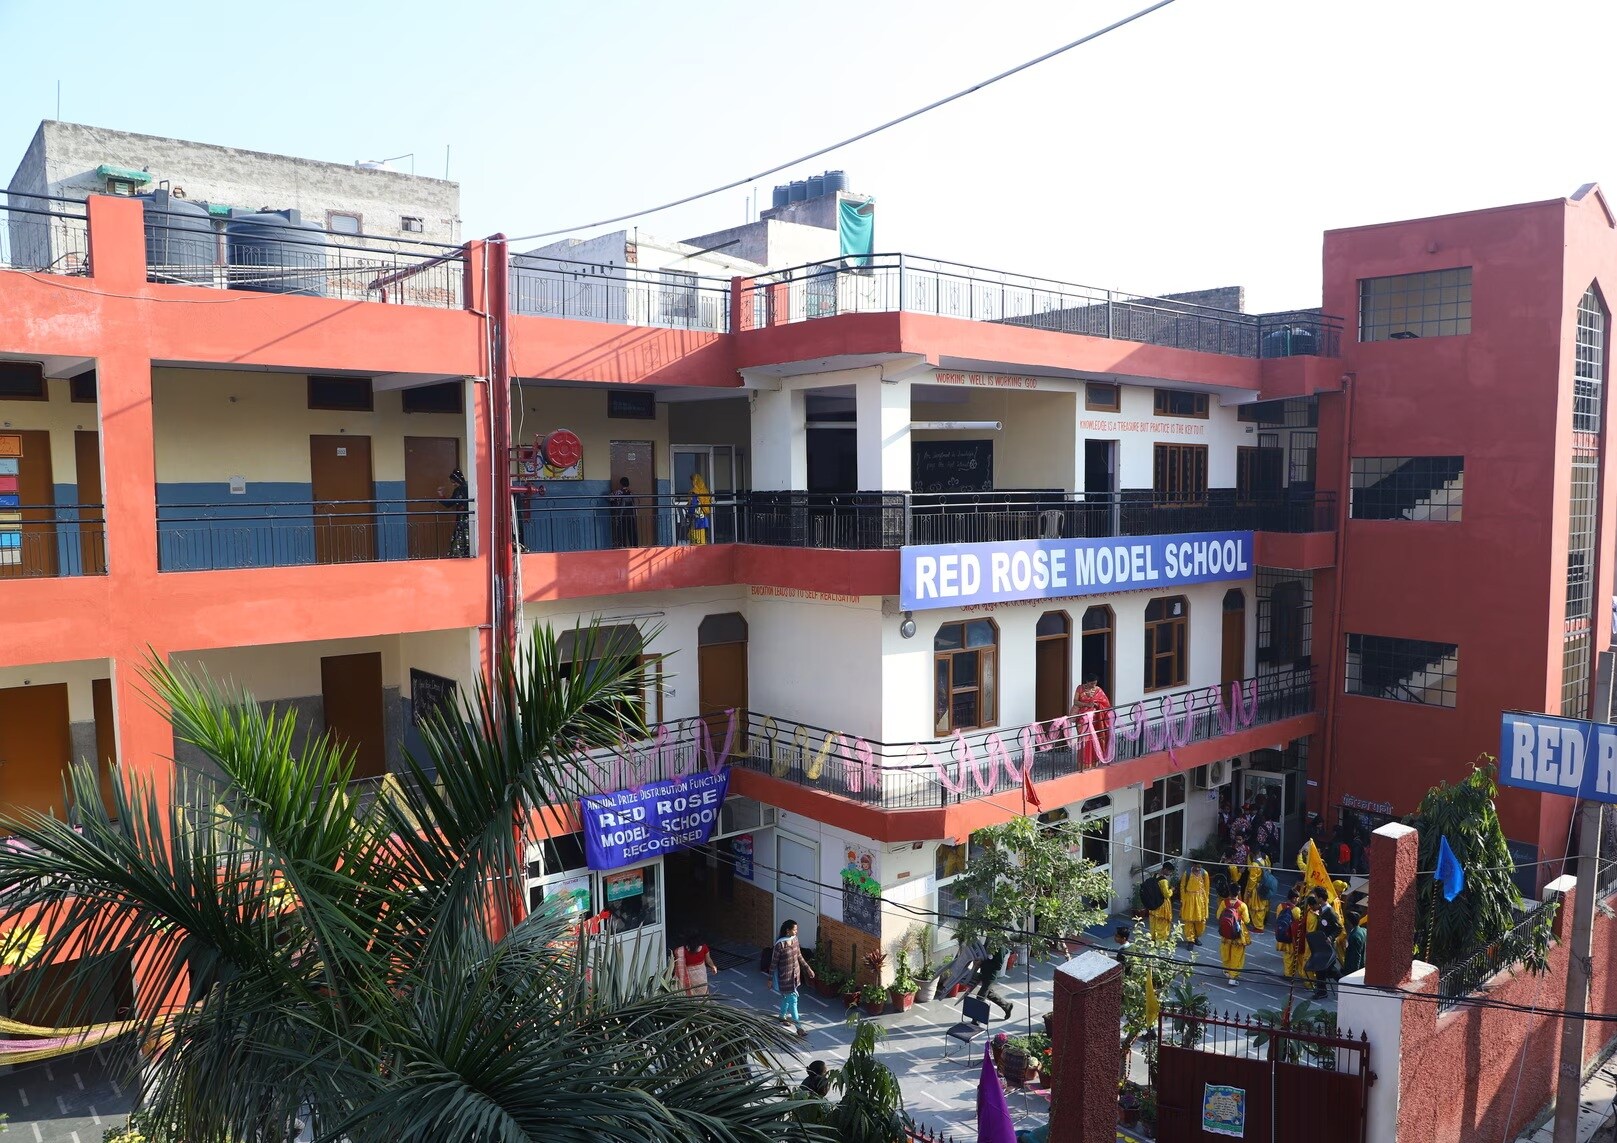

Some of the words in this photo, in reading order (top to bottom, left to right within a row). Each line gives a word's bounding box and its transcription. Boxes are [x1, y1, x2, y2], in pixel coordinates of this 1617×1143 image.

[936, 373, 965, 384] WORKING
[969, 374, 985, 386] WELL
[988, 375, 993, 386] IS
[995, 376, 1022, 387] WORKING
[1080, 420, 1107, 431] KNOWLEDGE
[1117, 421, 1139, 432] TREASURE
[1140, 422, 1149, 433] BUT
[1150, 422, 1170, 434] PRACTICE
[1176, 424, 1184, 434] THE
[915, 553, 981, 600] RED
[991, 549, 1067, 593] ROSE
[1075, 544, 1159, 587] MODEL
[1165, 539, 1247, 579] SCHOOL
[805, 590, 818, 600] SELF
[1510, 721, 1585, 788] RED
[587, 798, 617, 811] ANNUAL
[617, 793, 638, 806] PRIZE
[640, 782, 688, 800] DISTRIBUTION
[689, 773, 726, 790] FUNCTION
[598, 806, 646, 828] RED
[656, 789, 718, 815] ROSE
[600, 826, 650, 848] MODEL
[623, 829, 703, 859] RECOGNISED
